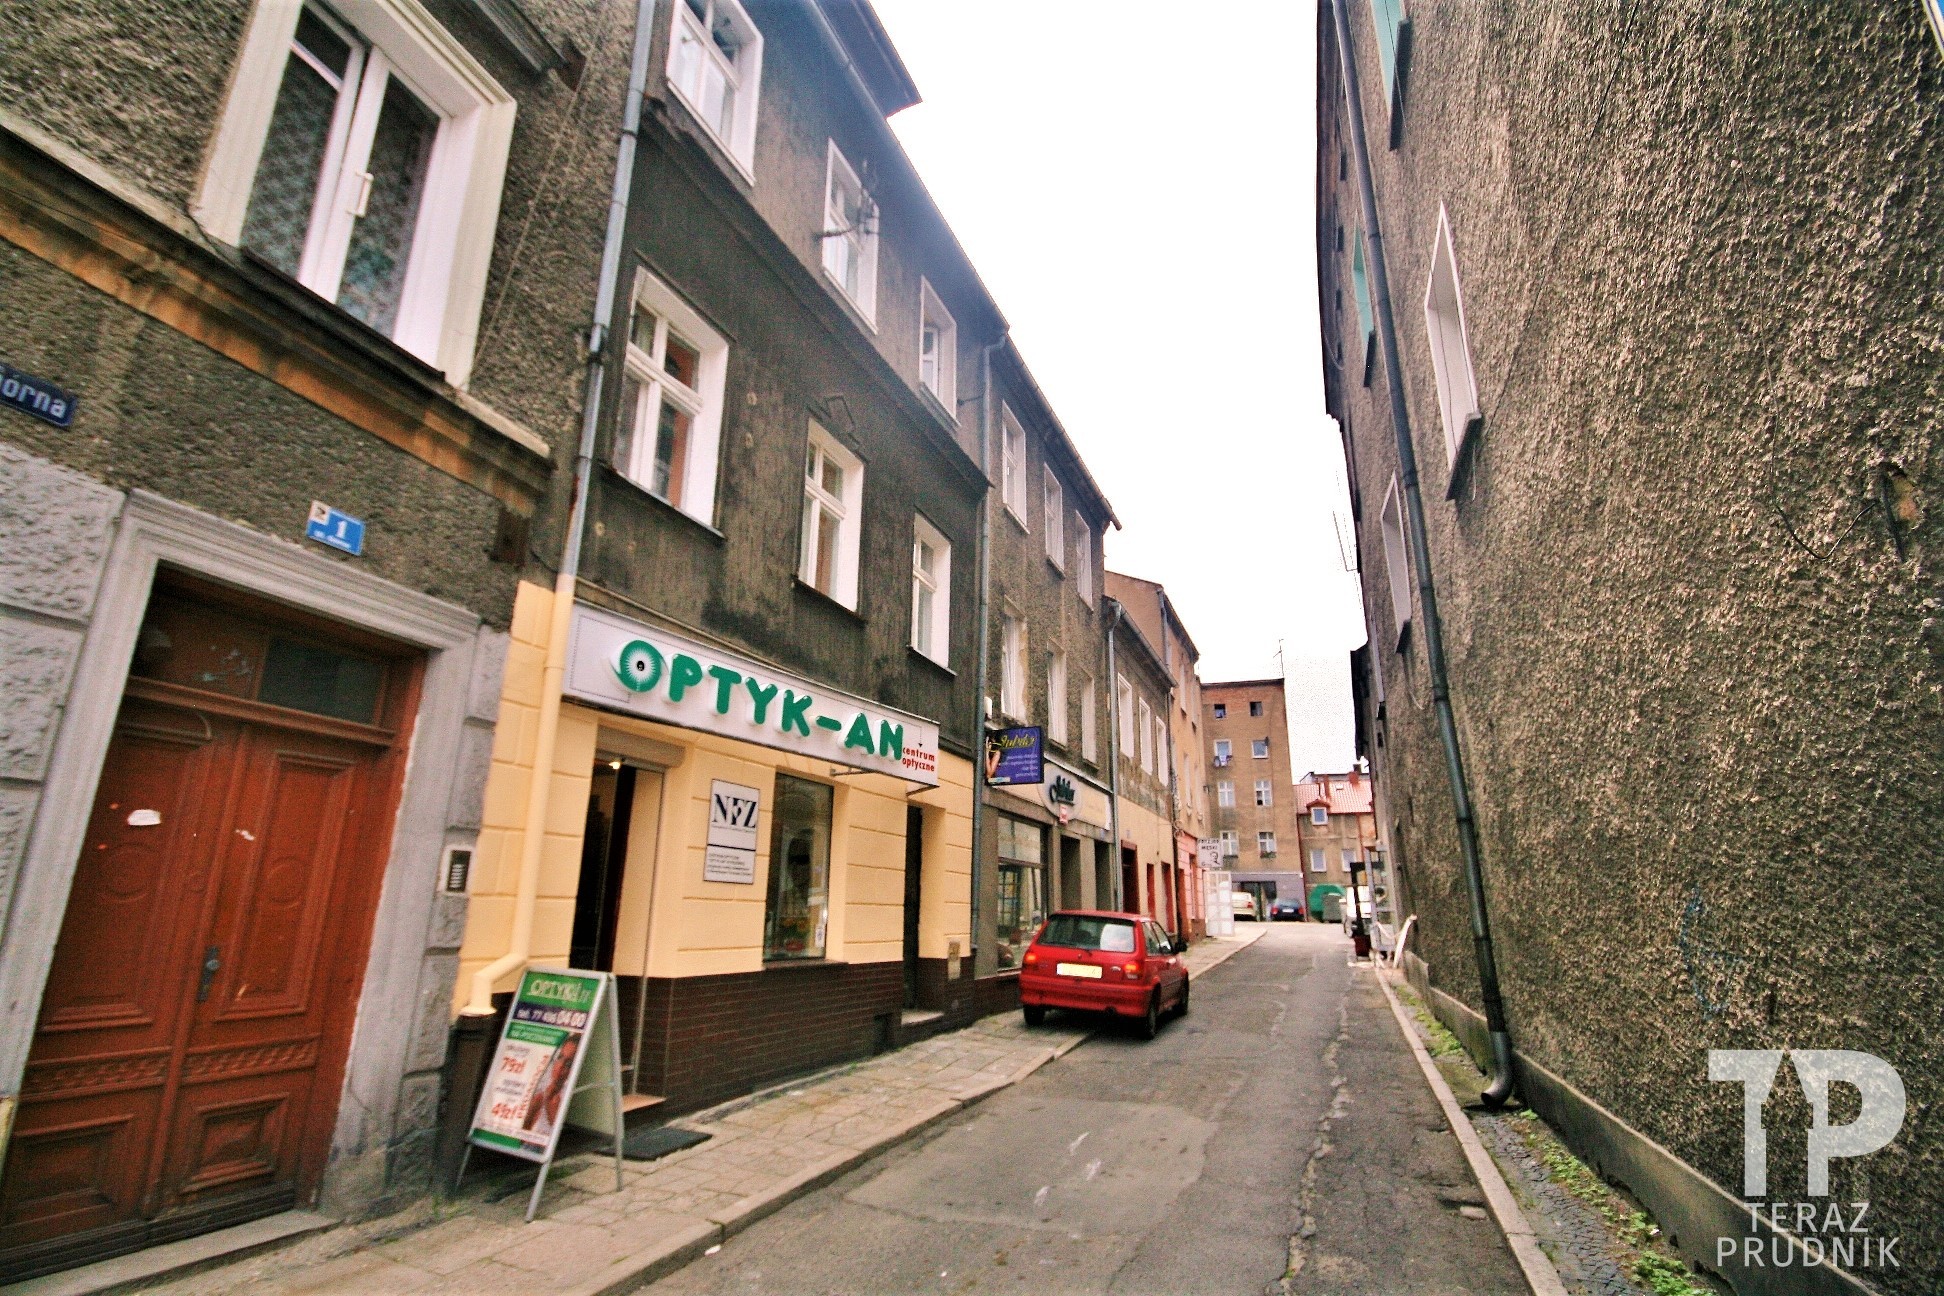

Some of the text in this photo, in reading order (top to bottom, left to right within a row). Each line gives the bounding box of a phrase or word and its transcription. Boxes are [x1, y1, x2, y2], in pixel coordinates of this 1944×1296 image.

[335, 520, 347, 539] 1
[611, 639, 904, 760] OPTYK-AN
[902, 747, 935, 762] centrum
[902, 757, 935, 772] optyczne
[711, 793, 757, 829] NFZ
